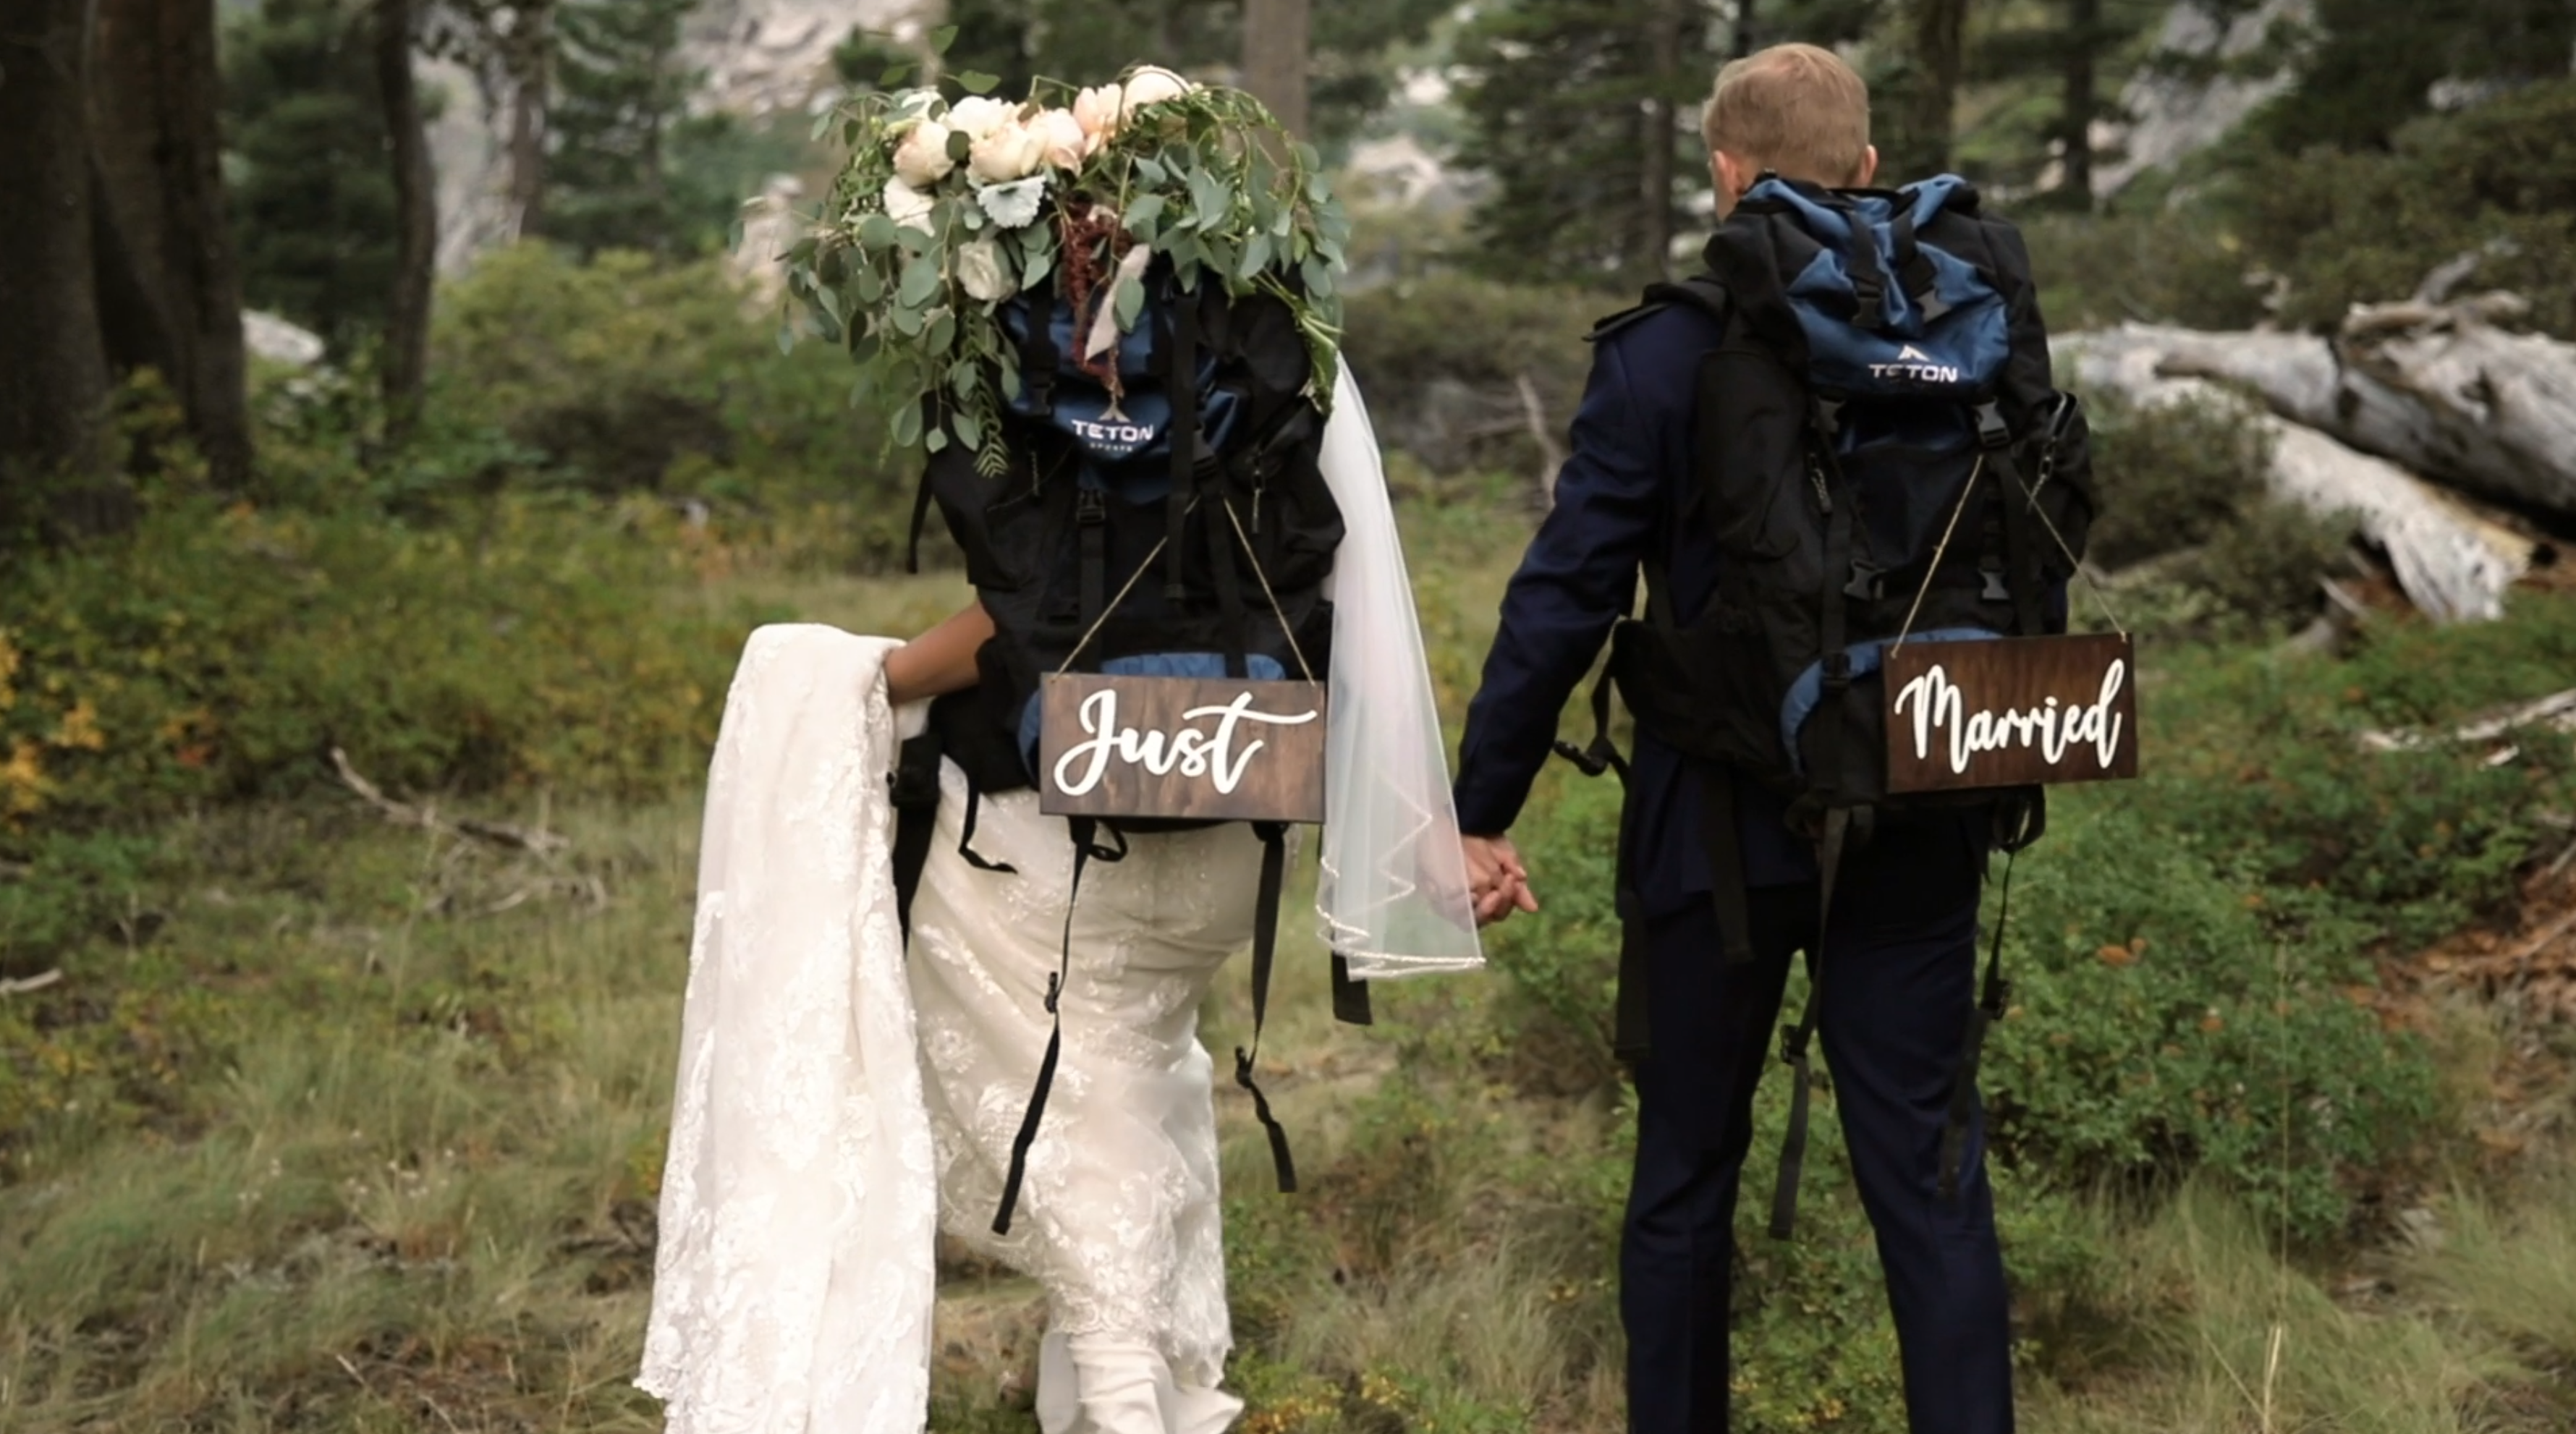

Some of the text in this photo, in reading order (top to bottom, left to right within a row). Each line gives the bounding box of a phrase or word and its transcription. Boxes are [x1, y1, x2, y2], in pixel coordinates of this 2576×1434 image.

[1072, 420, 1153, 442] TETON
[1054, 689, 1318, 796] Just
[1894, 658, 2124, 774] Married
